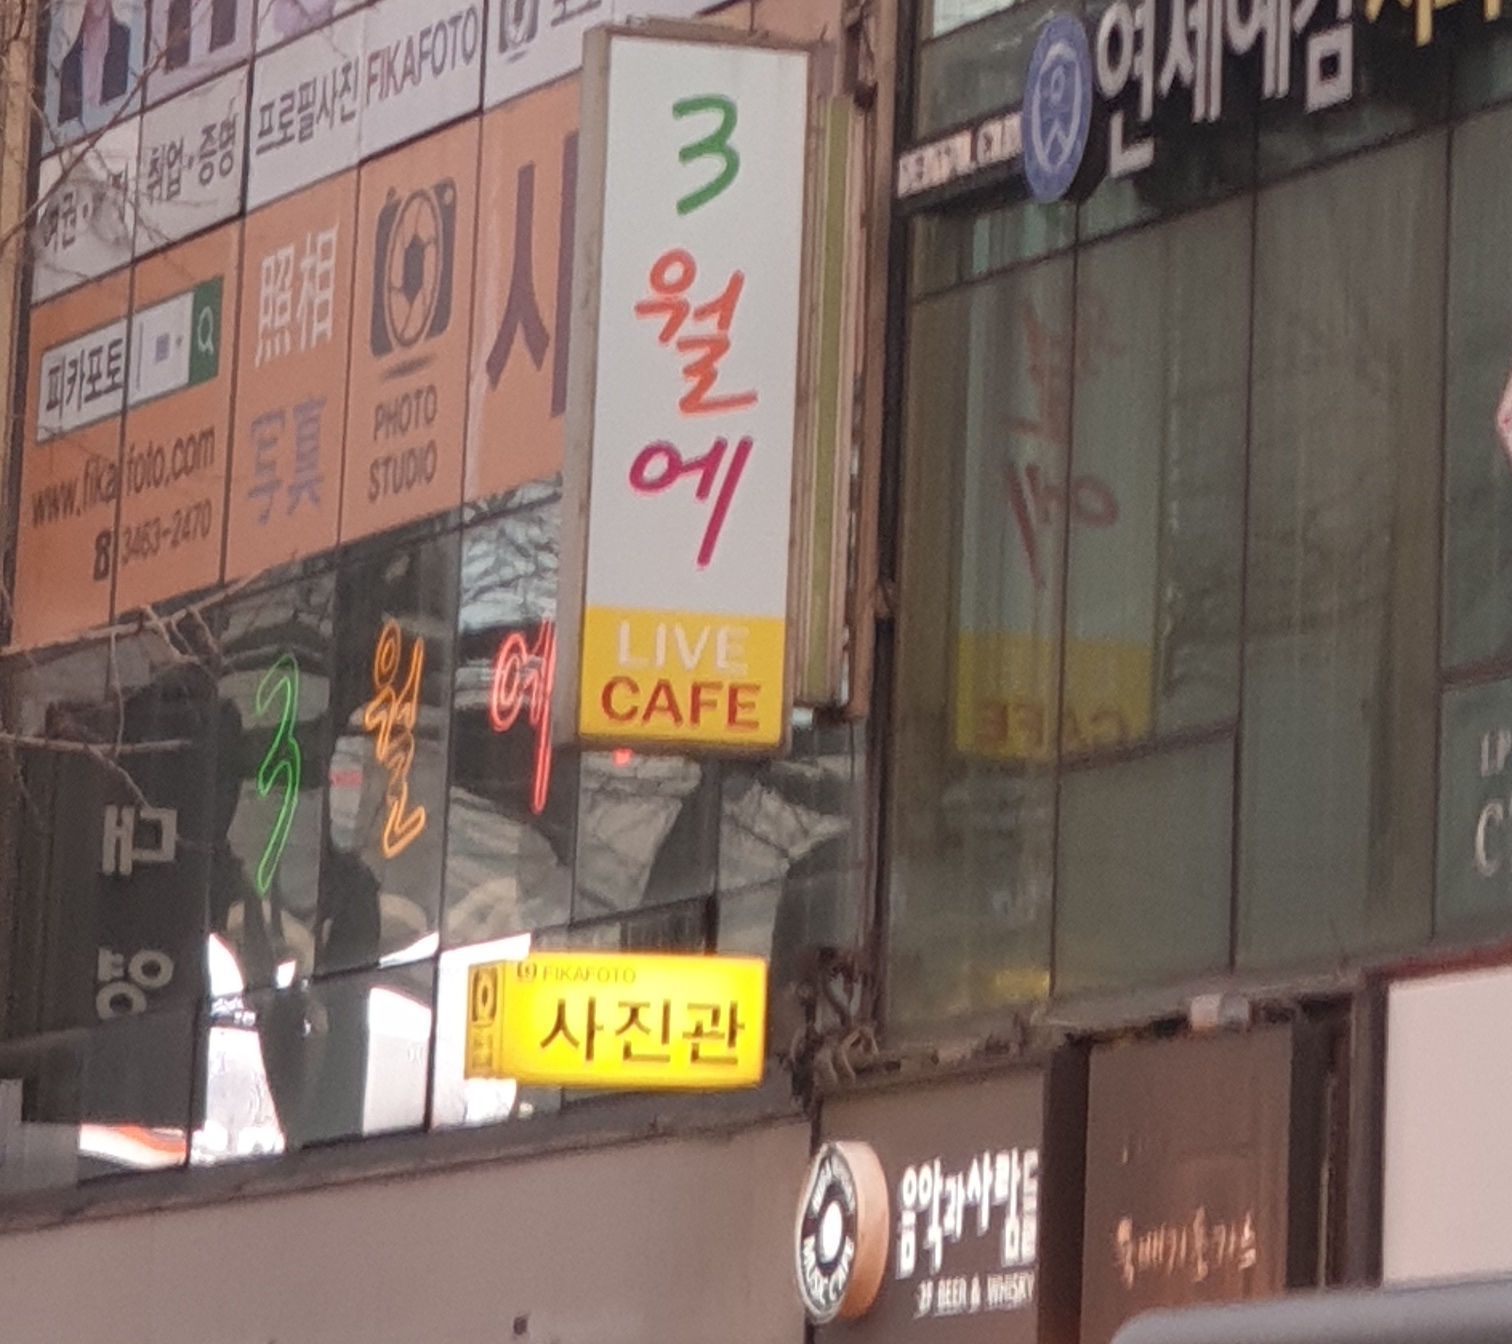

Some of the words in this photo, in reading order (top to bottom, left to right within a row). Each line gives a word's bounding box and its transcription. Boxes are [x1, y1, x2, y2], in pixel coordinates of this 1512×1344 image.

[364, 2, 480, 108] FIKAFOTO
[628, 92, 760, 569] 3월에
[46, 334, 125, 420] 피카포토
[372, 382, 438, 444] PHOTO
[367, 442, 438, 504] STUDIO
[616, 621, 750, 676] LIVE
[600, 675, 763, 732] CAFE
[542, 965, 637, 985] FIKAFOTO
[539, 995, 746, 1067] 사진관
